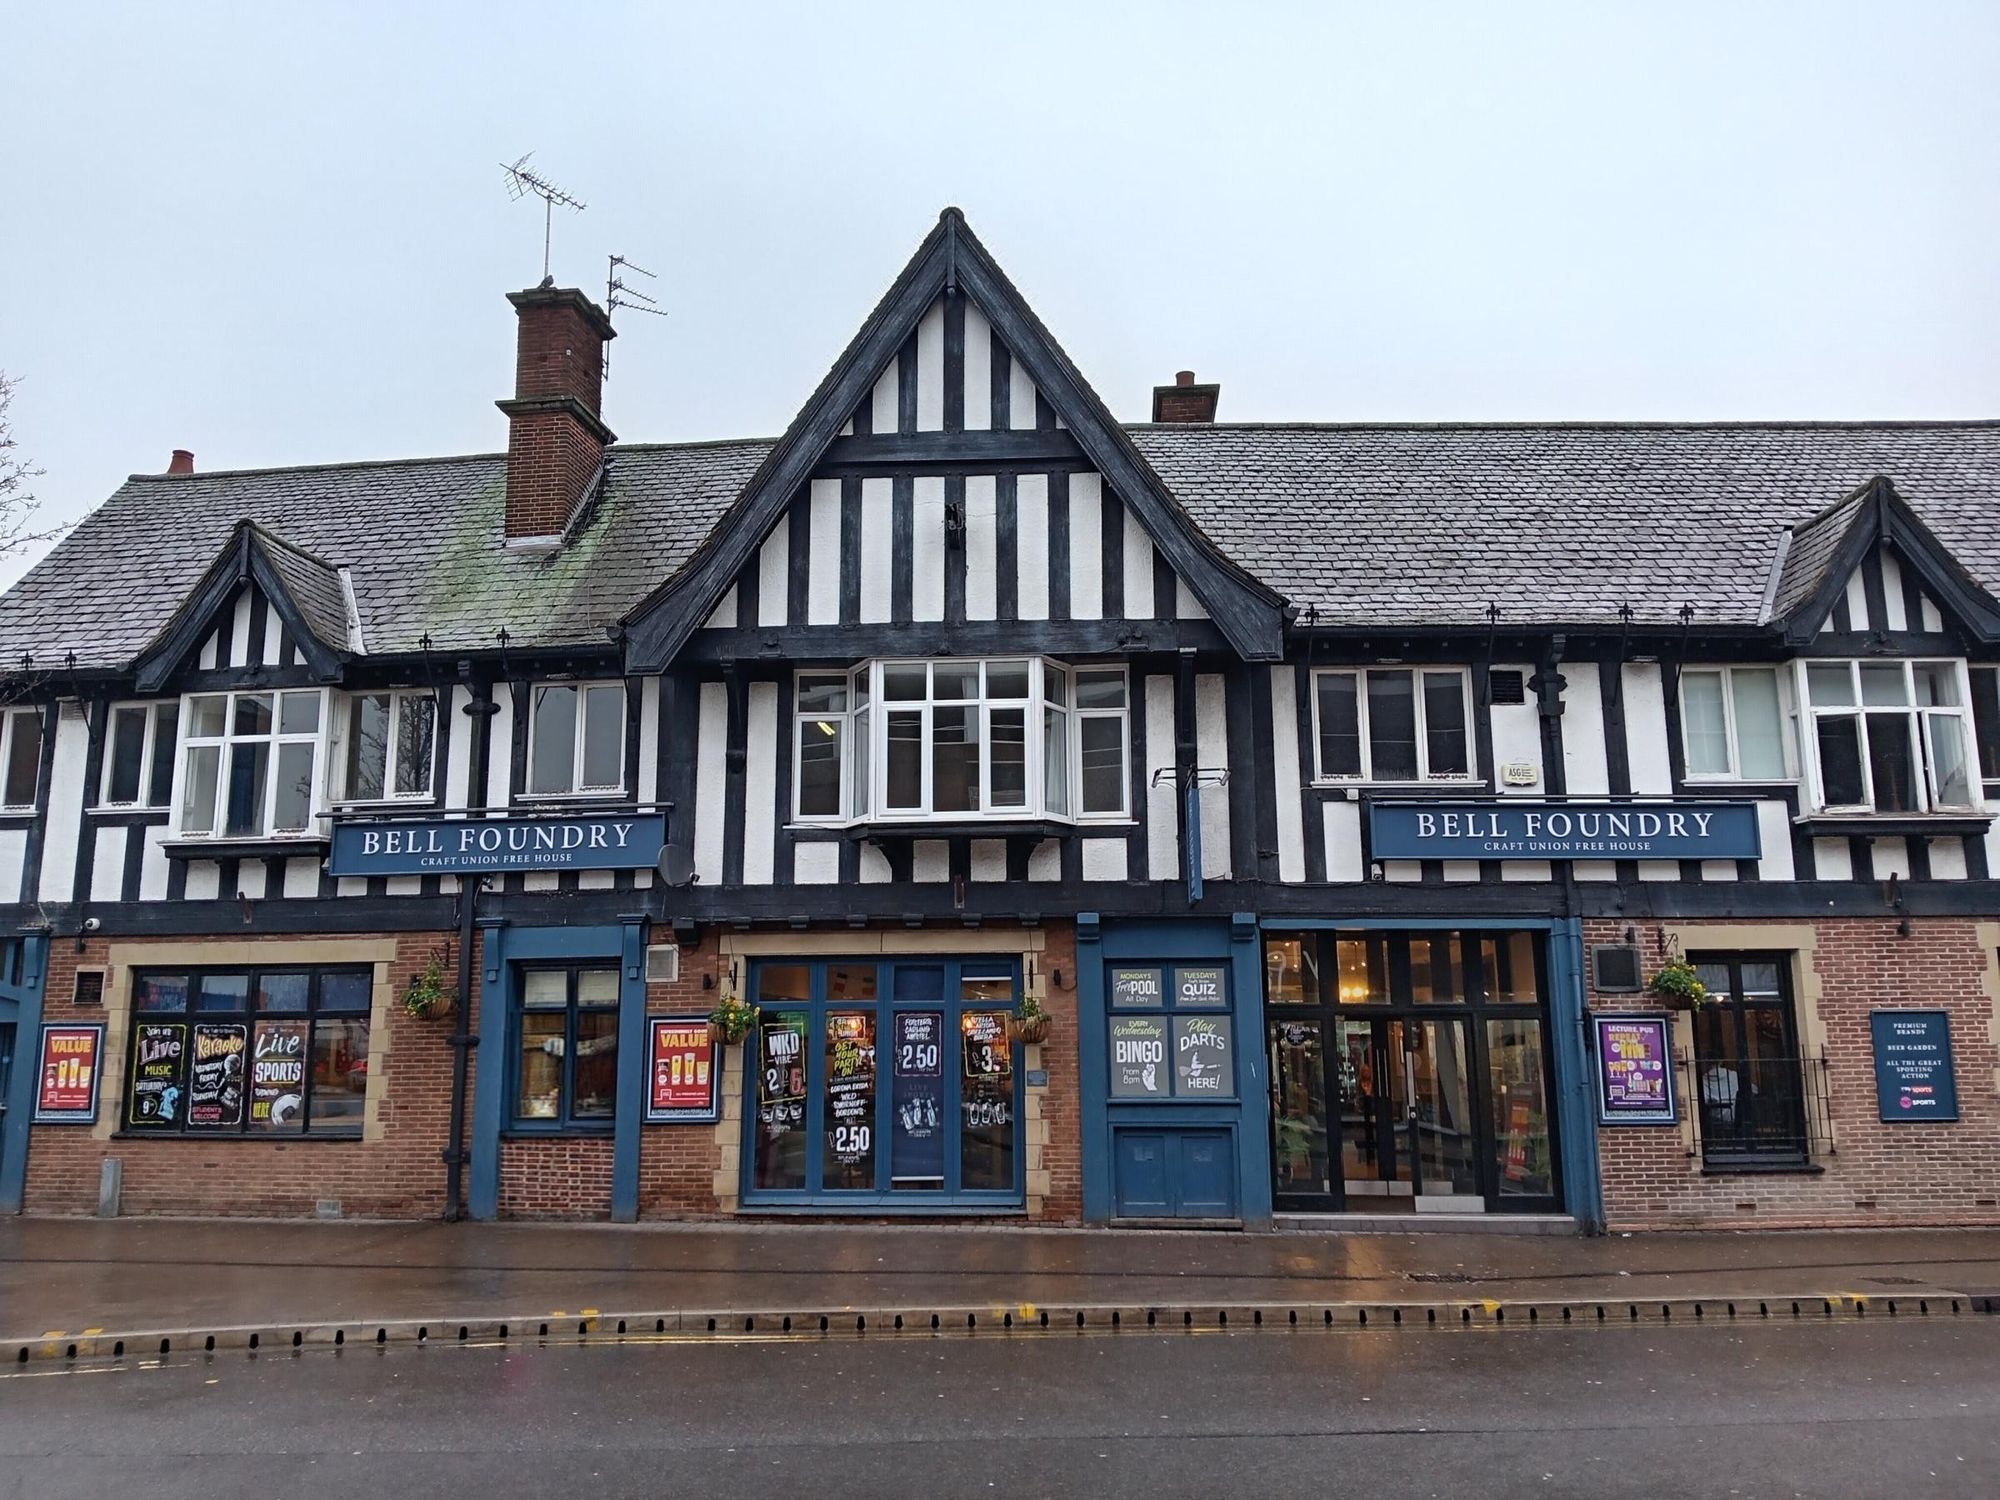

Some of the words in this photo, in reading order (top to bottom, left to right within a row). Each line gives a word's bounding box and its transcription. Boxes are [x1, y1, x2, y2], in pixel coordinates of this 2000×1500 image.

[1509, 768, 1521, 777] ASG
[1416, 813, 1508, 838] BELL
[1525, 812, 1714, 838] FOUNDRY
[362, 829, 443, 855] BELL
[458, 823, 633, 852] FOUNDRY
[1484, 841, 1524, 851] CRAFT
[1530, 841, 1571, 851] UNION
[1575, 841, 1605, 851] FREE
[1610, 841, 1651, 851] HOUSE
[421, 856, 457, 866] CRAFT
[461, 855, 499, 865] UNION
[503, 854, 530, 864] FREE
[535, 853, 572, 863] HOUSE
[1131, 981, 1158, 995] POOL
[1182, 983, 1217, 996] QUIZ
[1136, 995, 1148, 1003] Day
[146, 1027, 161, 1036] Join
[1113, 1025, 1162, 1038] Wednesday
[1187, 1018, 1216, 1036] Play
[661, 1034, 708, 1048] VALUE
[1180, 1032, 1225, 1052] DARTS
[1608, 1033, 1641, 1041] REPEAT
[51, 1040, 92, 1053] VALUE
[197, 1034, 244, 1060] Karaoke
[255, 1033, 300, 1058] Live
[768, 1033, 799, 1056] WKD
[835, 1041, 853, 1052] GET
[140, 1039, 181, 1065] Live
[1116, 1041, 1163, 1063] BINGO
[774, 1055, 792, 1065] VIBE
[144, 1065, 173, 1076] MUSIC
[255, 1062, 301, 1083] SPORTS
[842, 1067, 852, 1077] ON
[199, 1073, 219, 1083] FRIDAY
[1123, 1075, 1140, 1085] 8pm
[1188, 1074, 1221, 1090] HERE!
[192, 1090, 219, 1101] SUNDAY
[253, 1102, 270, 1118] HERE
